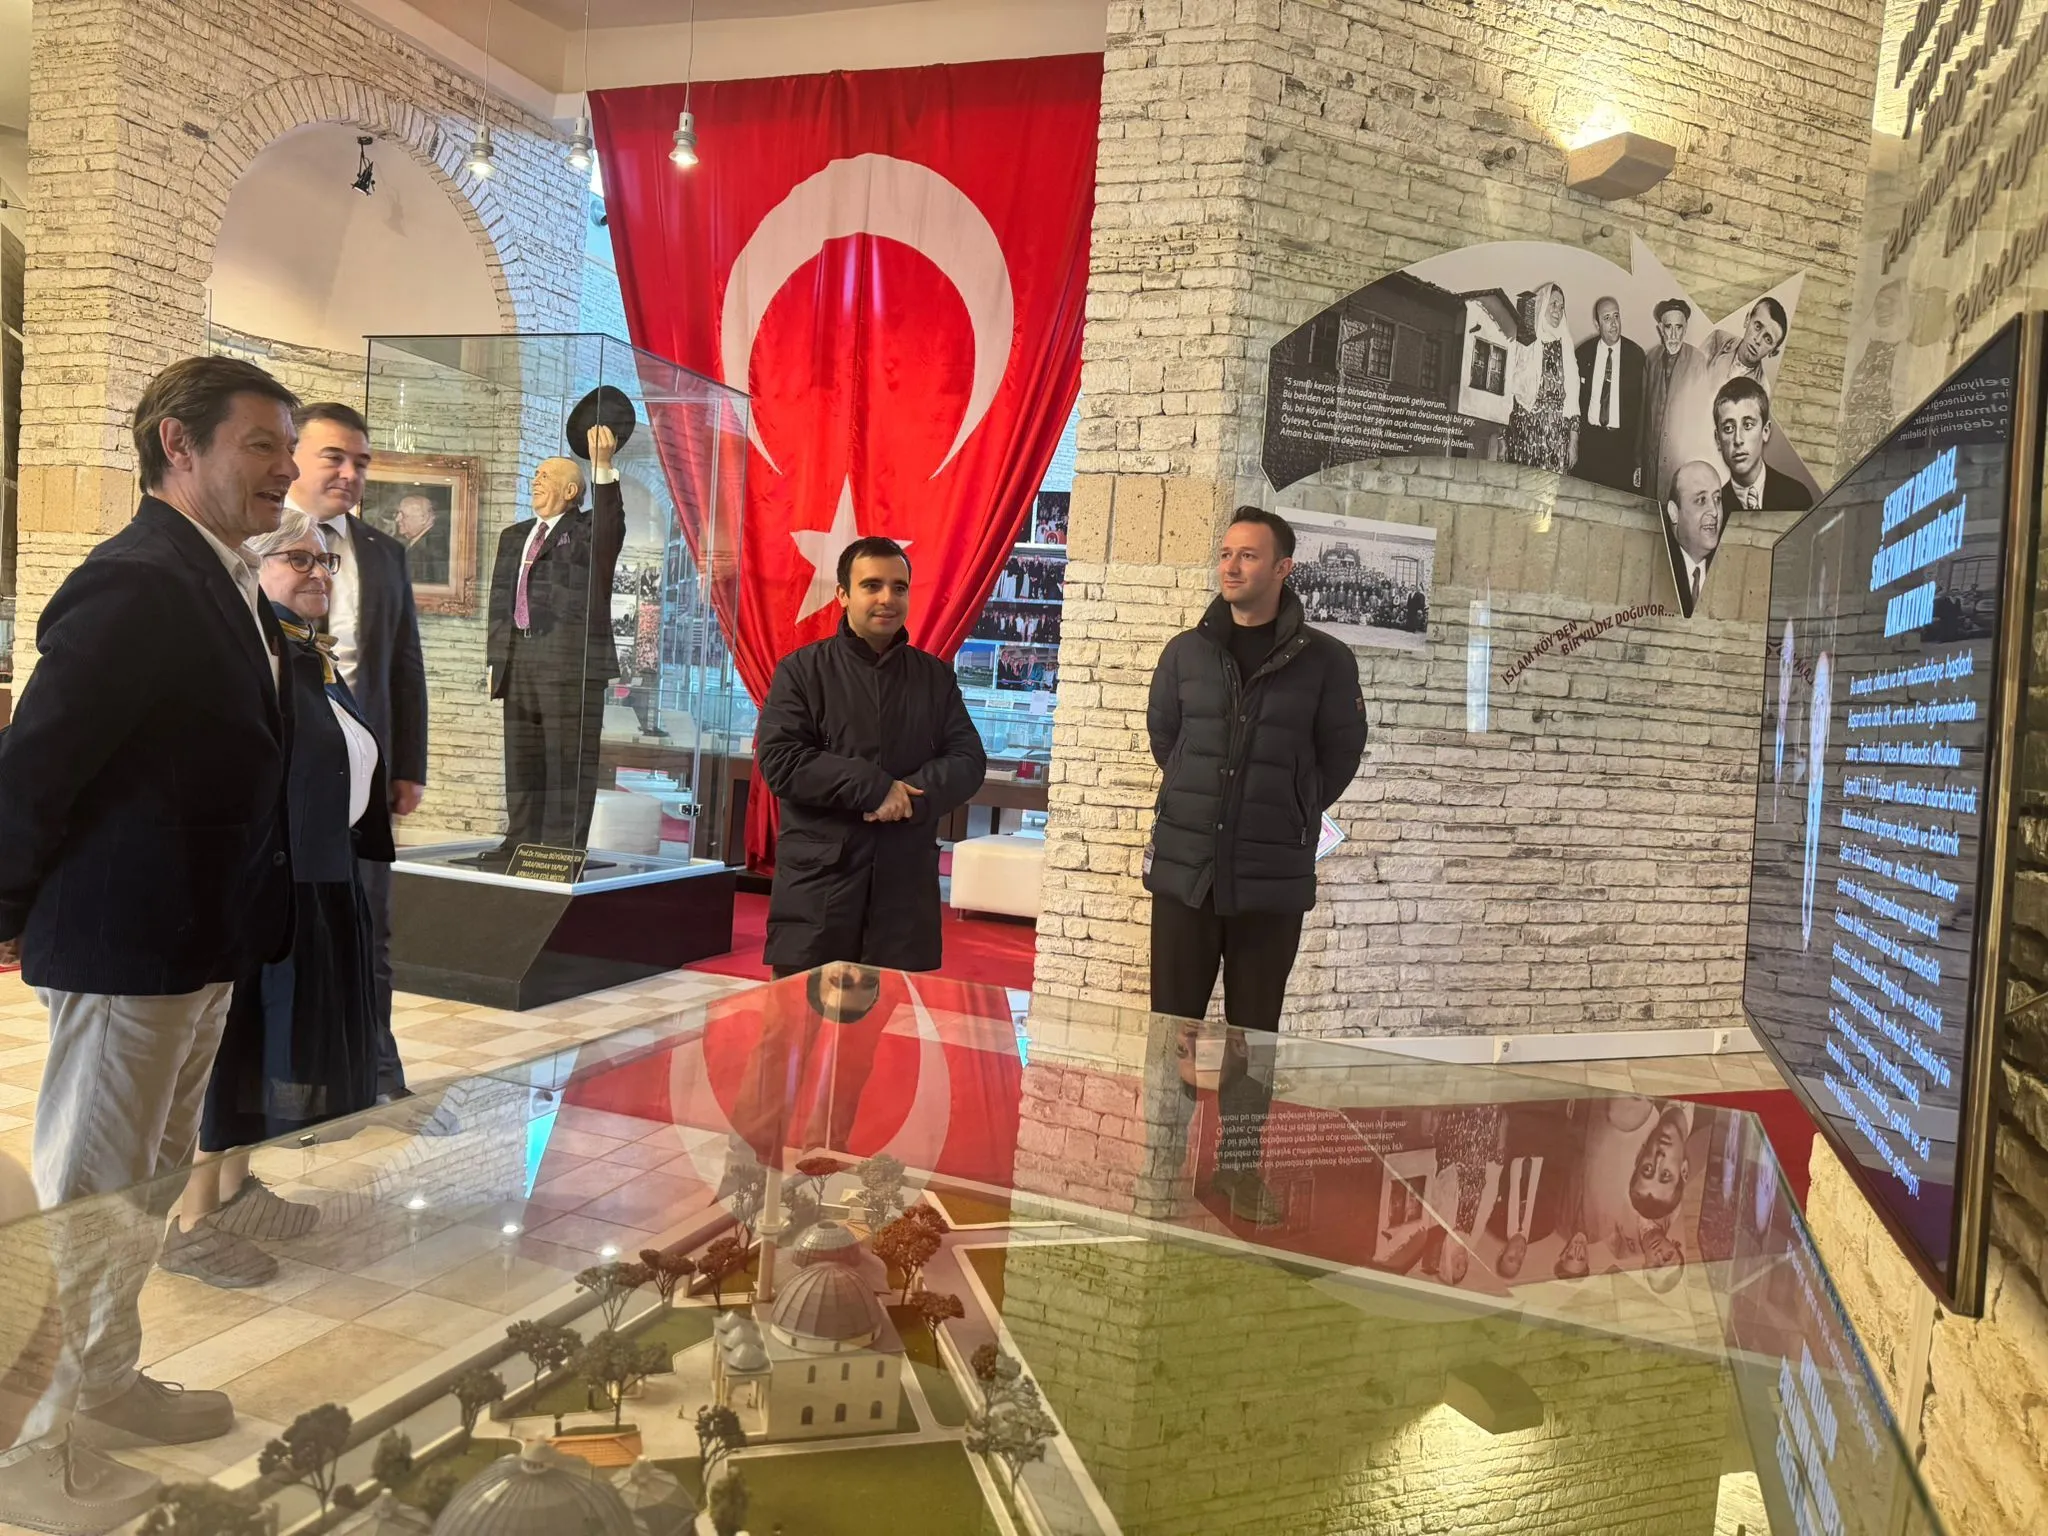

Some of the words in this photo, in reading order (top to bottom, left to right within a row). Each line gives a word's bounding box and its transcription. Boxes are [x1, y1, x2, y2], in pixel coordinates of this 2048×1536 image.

[1947, 248, 2008, 356] Şevket
[1282, 389, 1293, 398] Bu
[1294, 390, 1321, 403] benden
[1322, 394, 1335, 405] çok
[1336, 397, 1362, 409] Türkiye
[1418, 410, 1453, 424] övüneceği
[1454, 414, 1463, 424] bir
[1464, 417, 1476, 426] şey.
[1293, 379, 1313, 389] sınıflı
[1313, 381, 1335, 392] kerpiç
[1337, 384, 1347, 393] bir
[1347, 386, 1377, 398] binadan
[1377, 391, 1410, 404] okuyarak
[1411, 397, 1447, 409] geliyorum.
[1280, 427, 1302, 438] Aman
[1303, 431, 1313, 439] bu
[1314, 432, 1340, 443] ülkenin
[1341, 435, 1370, 448] değerini
[1371, 440, 1380, 450] iyi
[1281, 414, 1311, 428] Öyleyse,
[1362, 426, 1383, 438] eşitlik
[1384, 429, 1412, 441] ilkesinin
[1413, 433, 1441, 445] değerini
[1441, 437, 1450, 447] iyi
[1451, 438, 1475, 450] bilelim.
[1295, 404, 1305, 413] bir
[1306, 405, 1326, 418] köylü
[1362, 414, 1374, 424] her
[1375, 416, 1392, 428] şeyin
[1394, 419, 1408, 428] açık
[1409, 421, 1432, 431] olması
[1432, 424, 1464, 436] demektir.
[1884, 581, 1936, 639] ANLATIYOR
[1560, 636, 1581, 656] BİR
[1579, 616, 1614, 642] YILDIZ
[1615, 604, 1675, 625] DOĞUYOR...
[1500, 653, 1535, 686] İSLAM
[1533, 621, 1578, 658] KÖY'DEN
